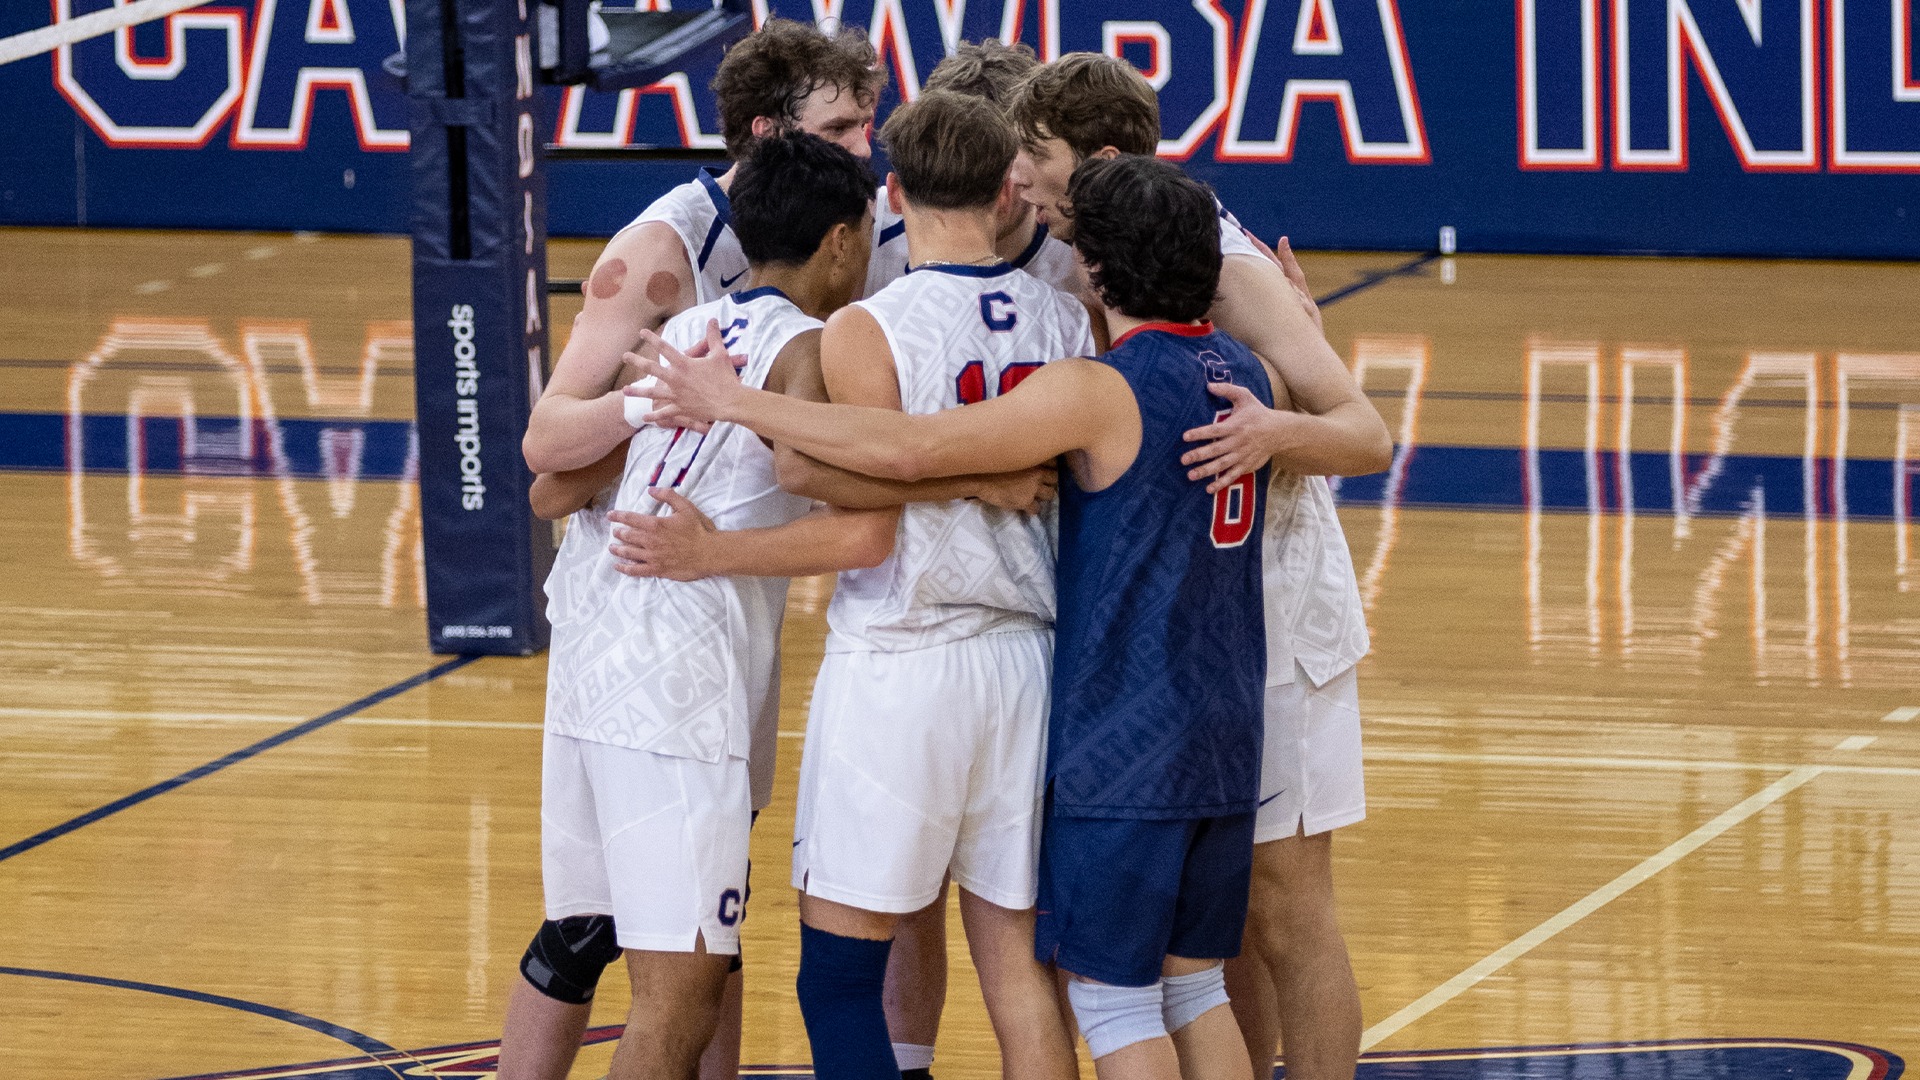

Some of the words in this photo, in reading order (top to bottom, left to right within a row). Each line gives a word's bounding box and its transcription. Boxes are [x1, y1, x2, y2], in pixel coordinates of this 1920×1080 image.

[1516, 0, 1920, 173] IN
[447, 304, 480, 396] sports
[978, 290, 1017, 333] C
[454, 399, 486, 511] imports
[718, 887, 742, 926] C
